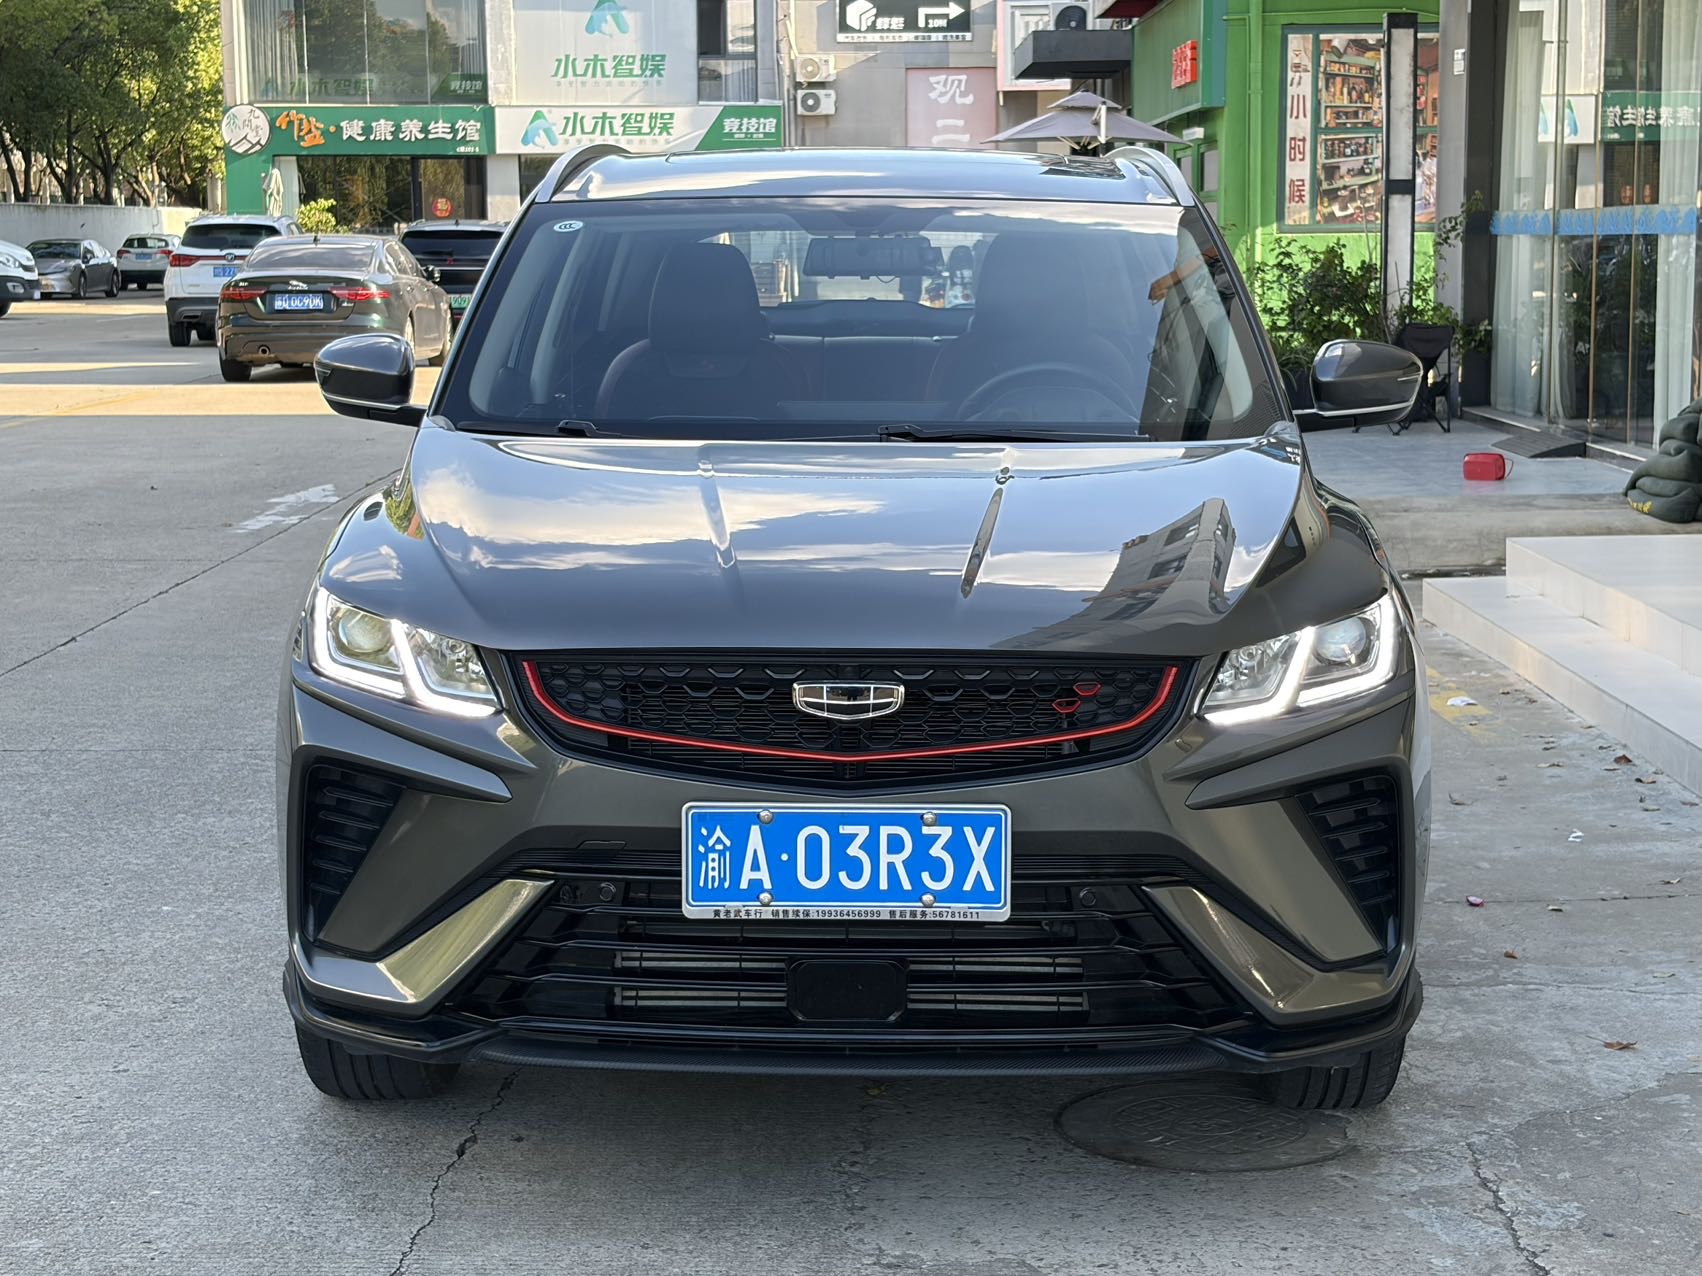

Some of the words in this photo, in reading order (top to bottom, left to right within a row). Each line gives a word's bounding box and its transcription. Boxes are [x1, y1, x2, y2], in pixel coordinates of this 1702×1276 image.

[551, 53, 667, 79] 水木智娱
[559, 111, 676, 137] 水木智娱
[722, 117, 777, 134] 竞技馆
[713, 909, 763, 919] 黄老武车行
[888, 909, 980, 920] 售后服务:56781611
